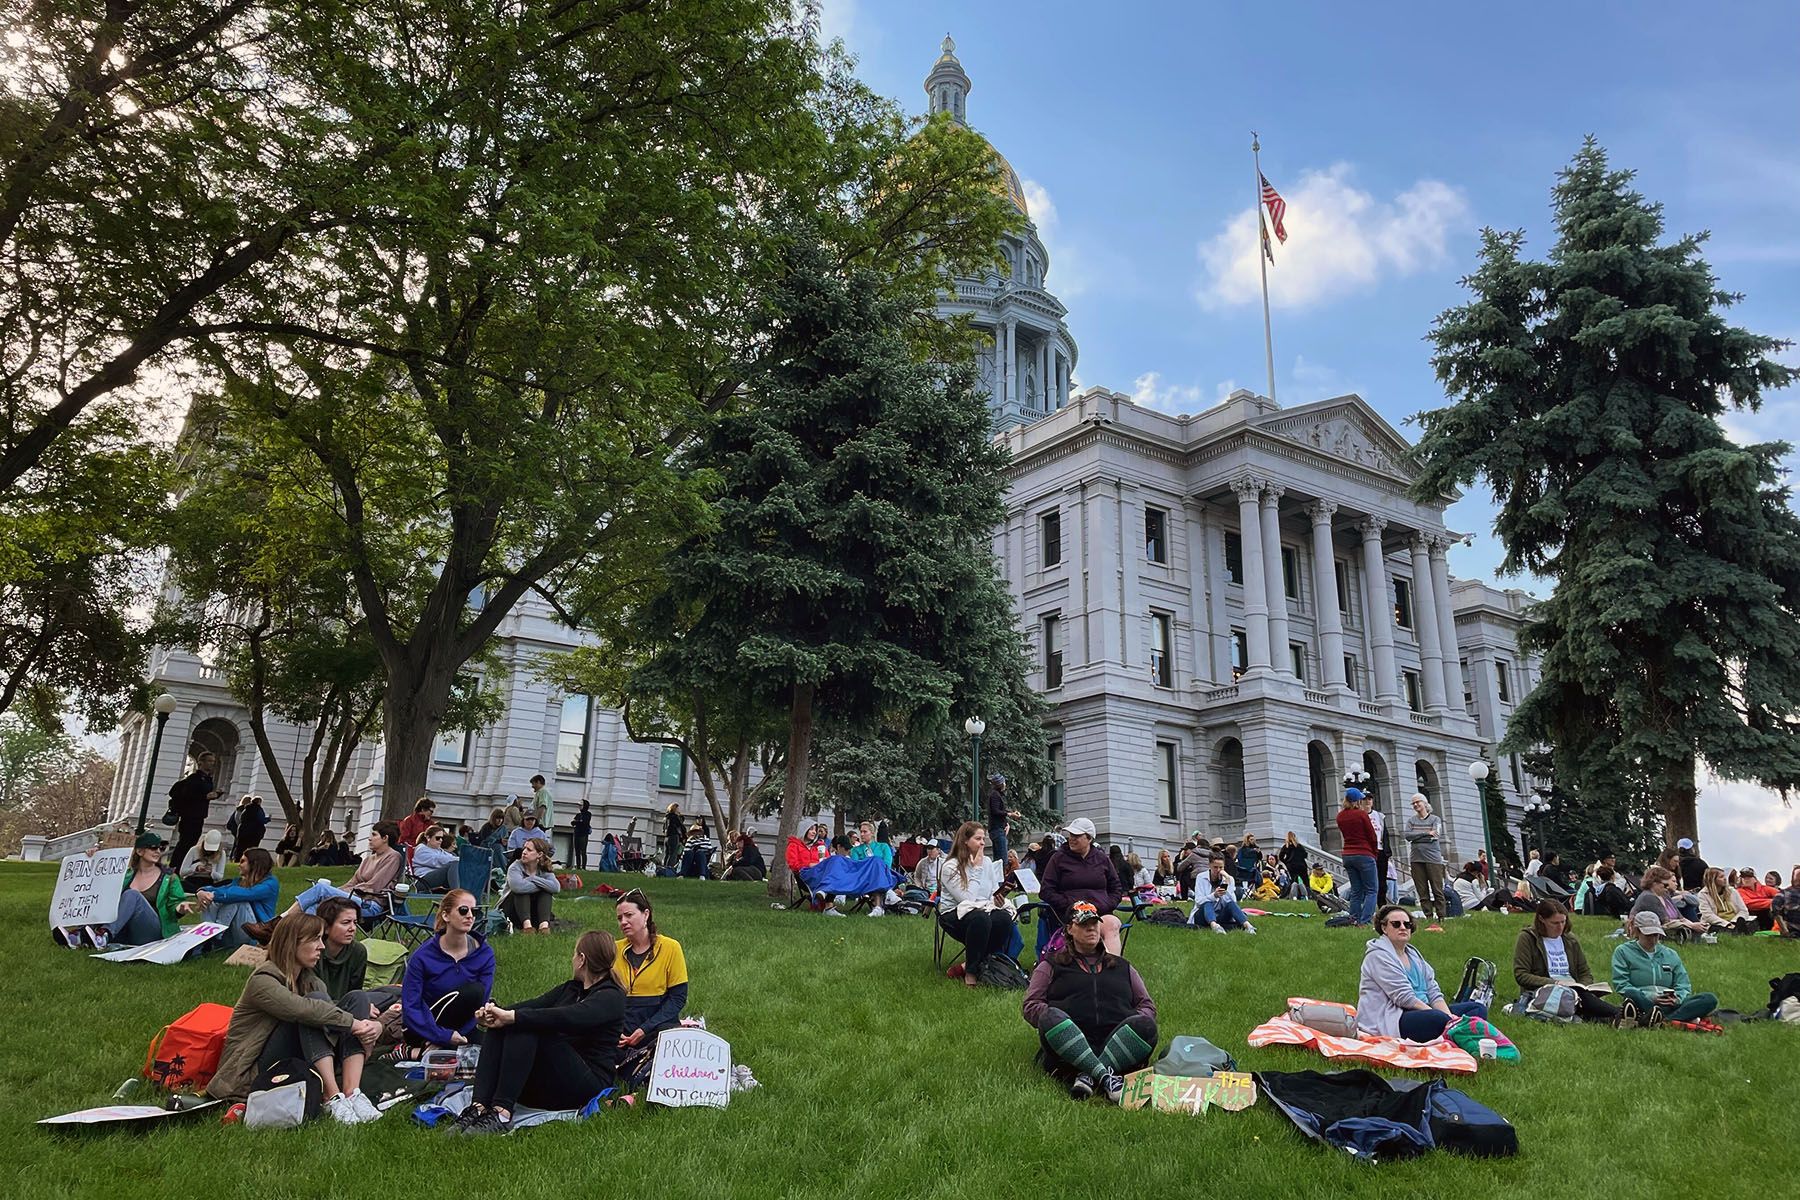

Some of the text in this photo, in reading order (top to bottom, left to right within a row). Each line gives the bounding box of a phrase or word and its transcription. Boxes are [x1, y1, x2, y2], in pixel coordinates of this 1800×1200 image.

[63, 856, 129, 881] BAN GUNS
[73, 878, 94, 893] and
[58, 894, 99, 910] BUY THEM
[62, 905, 91, 920] BACK!!
[663, 1038, 725, 1063] PROTECT
[658, 1064, 719, 1081] children
[655, 1087, 687, 1100] NOT
[1119, 1069, 1193, 1111] HERE
[1179, 1083, 1203, 1117] 4
[1217, 1072, 1251, 1089] the
